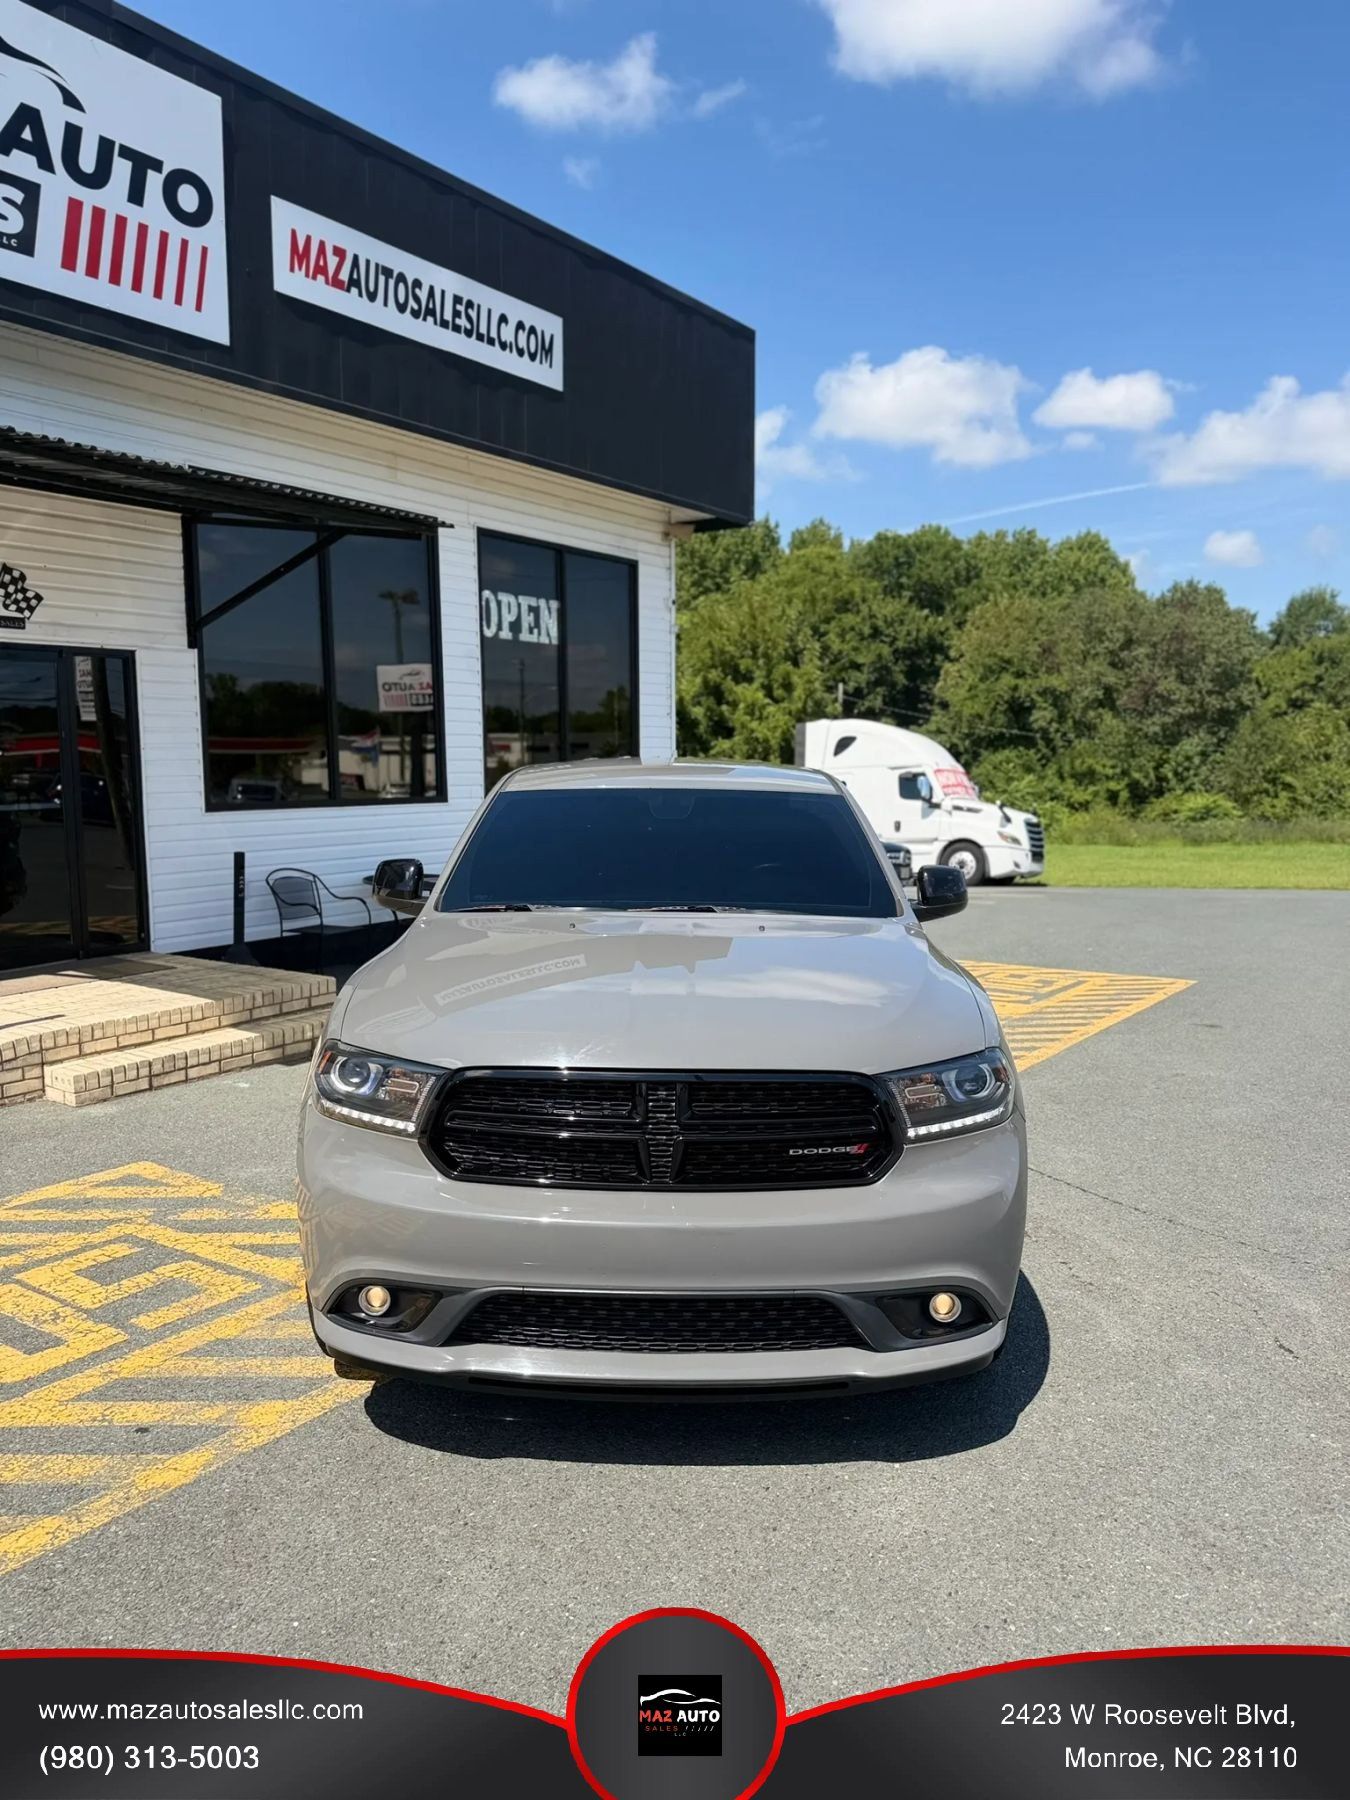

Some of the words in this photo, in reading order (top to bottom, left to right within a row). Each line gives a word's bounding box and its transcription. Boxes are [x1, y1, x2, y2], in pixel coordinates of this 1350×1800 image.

[0, 102, 214, 228] AUTO
[289, 228, 555, 369] MAZAUTOSALESLLC.COM
[481, 589, 561, 645] OPEN
[789, 1145, 860, 1156] DODGE
